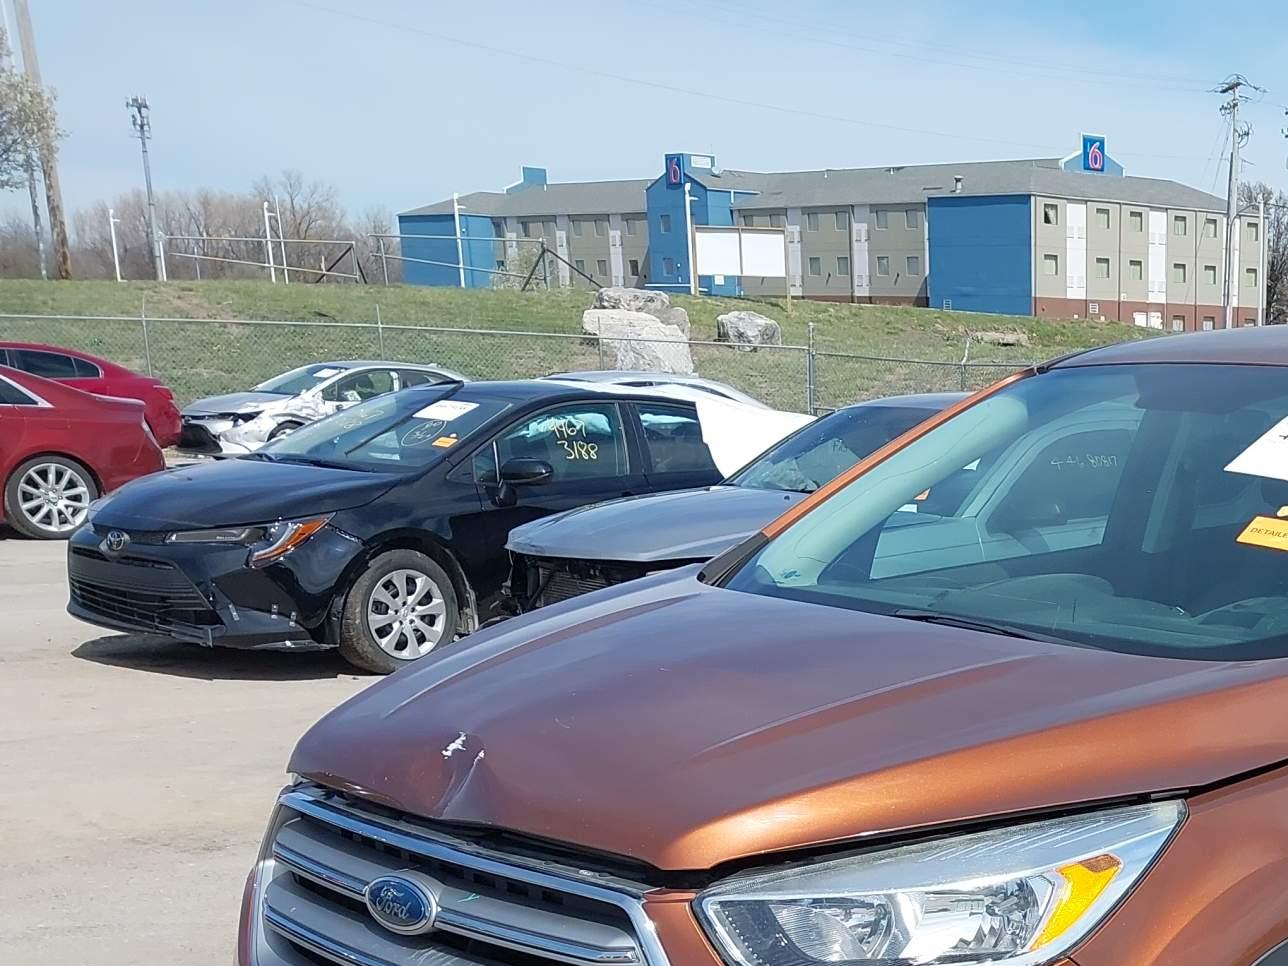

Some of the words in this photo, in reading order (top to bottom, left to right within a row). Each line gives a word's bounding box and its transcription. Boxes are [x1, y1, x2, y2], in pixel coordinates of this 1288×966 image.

[1089, 141, 1103, 169] 6
[556, 440, 599, 460] 3188
[375, 885, 412, 920] Ford
